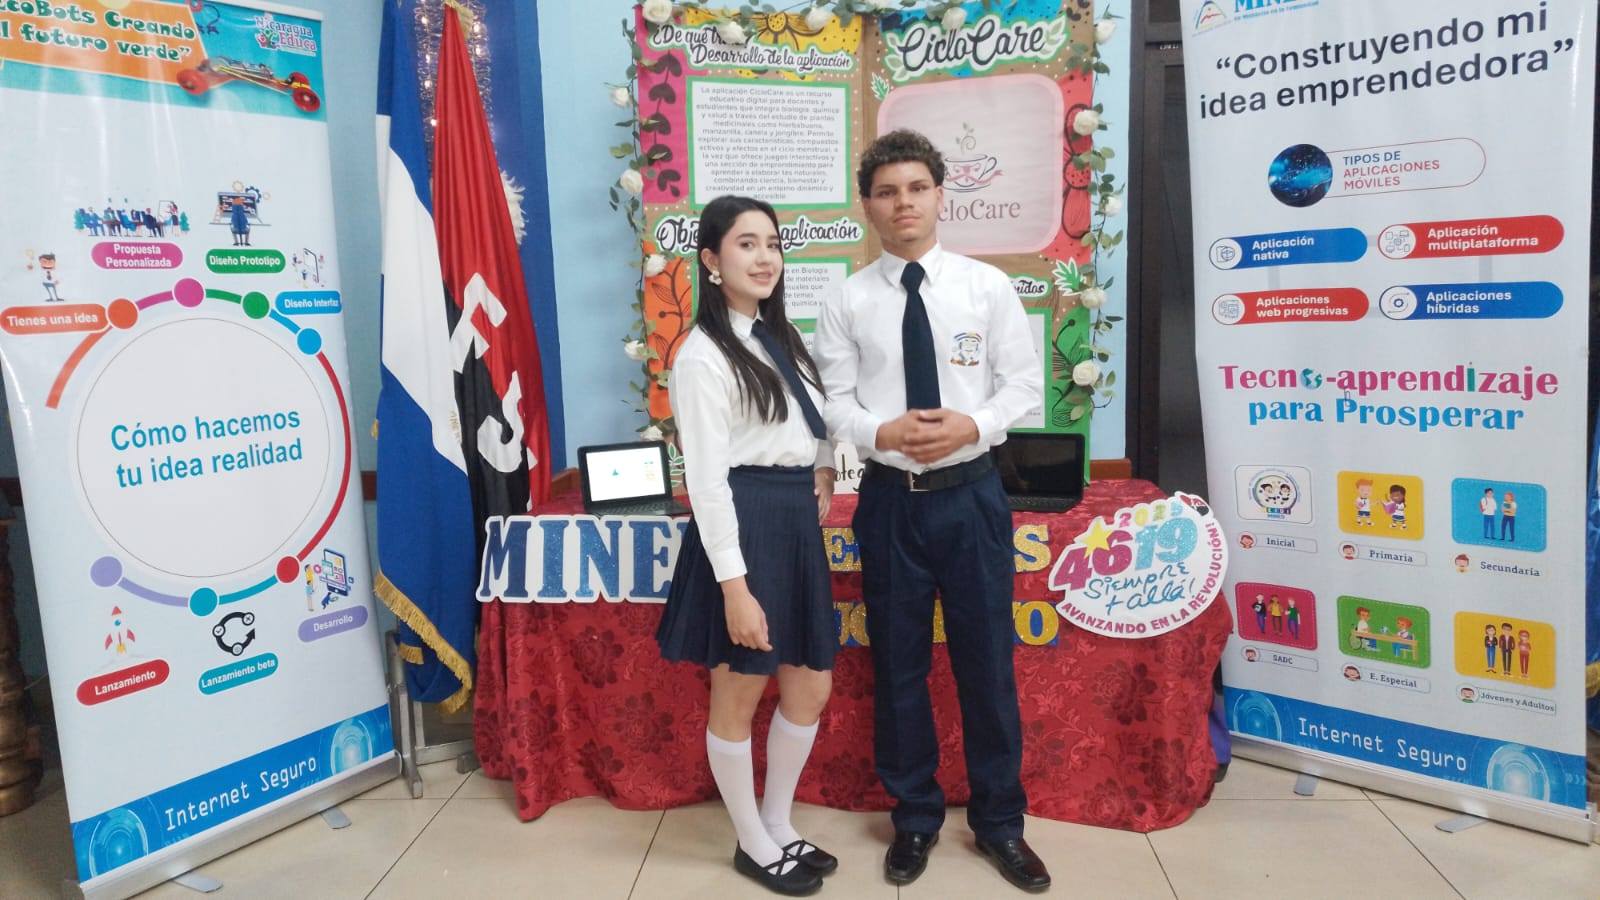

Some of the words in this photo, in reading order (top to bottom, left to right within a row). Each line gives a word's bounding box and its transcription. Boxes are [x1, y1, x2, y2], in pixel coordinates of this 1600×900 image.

[104, 11, 196, 40] Creando
[255, 15, 313, 37] Nicaragua
[20, 23, 108, 51] futuro
[279, 31, 316, 51] Educa
[897, 19, 1045, 71] CicloCare
[1216, 18, 1484, 79] “Construyendo
[1497, 1, 1547, 38] mi
[691, 43, 765, 64] Desarrollo
[764, 49, 783, 65] de
[783, 48, 795, 65] la
[796, 48, 850, 71] aplicación
[1200, 92, 1266, 119] idea
[1276, 38, 1574, 107] emprendedora”
[1343, 156, 1380, 166] TIPOS
[1384, 151, 1401, 161] DE
[1344, 160, 1440, 178] APLICACIONES
[1344, 176, 1400, 190] MÓVILES
[780, 217, 860, 248] aplicación
[1427, 225, 1498, 239] Aplicación
[113, 243, 161, 256] Propuesta
[1252, 236, 1315, 251] Aplicación
[1428, 236, 1539, 251] multiplataforma
[105, 257, 172, 268] Personalizada
[209, 255, 239, 266] Diseño
[240, 255, 281, 267] Prototipo
[1253, 250, 1289, 261] nativa
[284, 298, 312, 309] Diseño
[1256, 295, 1330, 308] Aplicaciones
[1426, 291, 1512, 303] Aplicaciones
[1256, 308, 1281, 317] web
[1284, 304, 1349, 318] progresivas
[1426, 303, 1480, 314] híbridas
[7, 315, 48, 327] Tienes
[51, 317, 72, 325] una
[74, 313, 99, 323] idea
[1249, 401, 1324, 426] para
[1336, 398, 1524, 432] Prosperar
[111, 422, 187, 451] Cómo
[194, 410, 301, 440] hacemos
[116, 463, 143, 488] tu
[150, 455, 203, 482] idea
[211, 437, 303, 473] realidad
[1266, 536, 1296, 548] Inicial
[479, 519, 690, 599] MINE
[1369, 549, 1413, 563] Primaria
[313, 614, 353, 632] Desarrollo
[1061, 602, 1146, 633] AVANZANDO
[1150, 616, 1169, 631] EN
[1172, 608, 1190, 622] LA
[201, 664, 256, 689] Lanzamiento
[256, 658, 276, 671] beta
[1369, 672, 1379, 681] E.
[1380, 674, 1418, 688] Especial
[94, 670, 157, 696] Lanzamiento
[1521, 699, 1555, 712] Adultos
[1298, 718, 1384, 753] Internet
[1397, 739, 1467, 771] Seguro
[164, 781, 250, 831] Internet
[259, 756, 317, 792] Seguro
